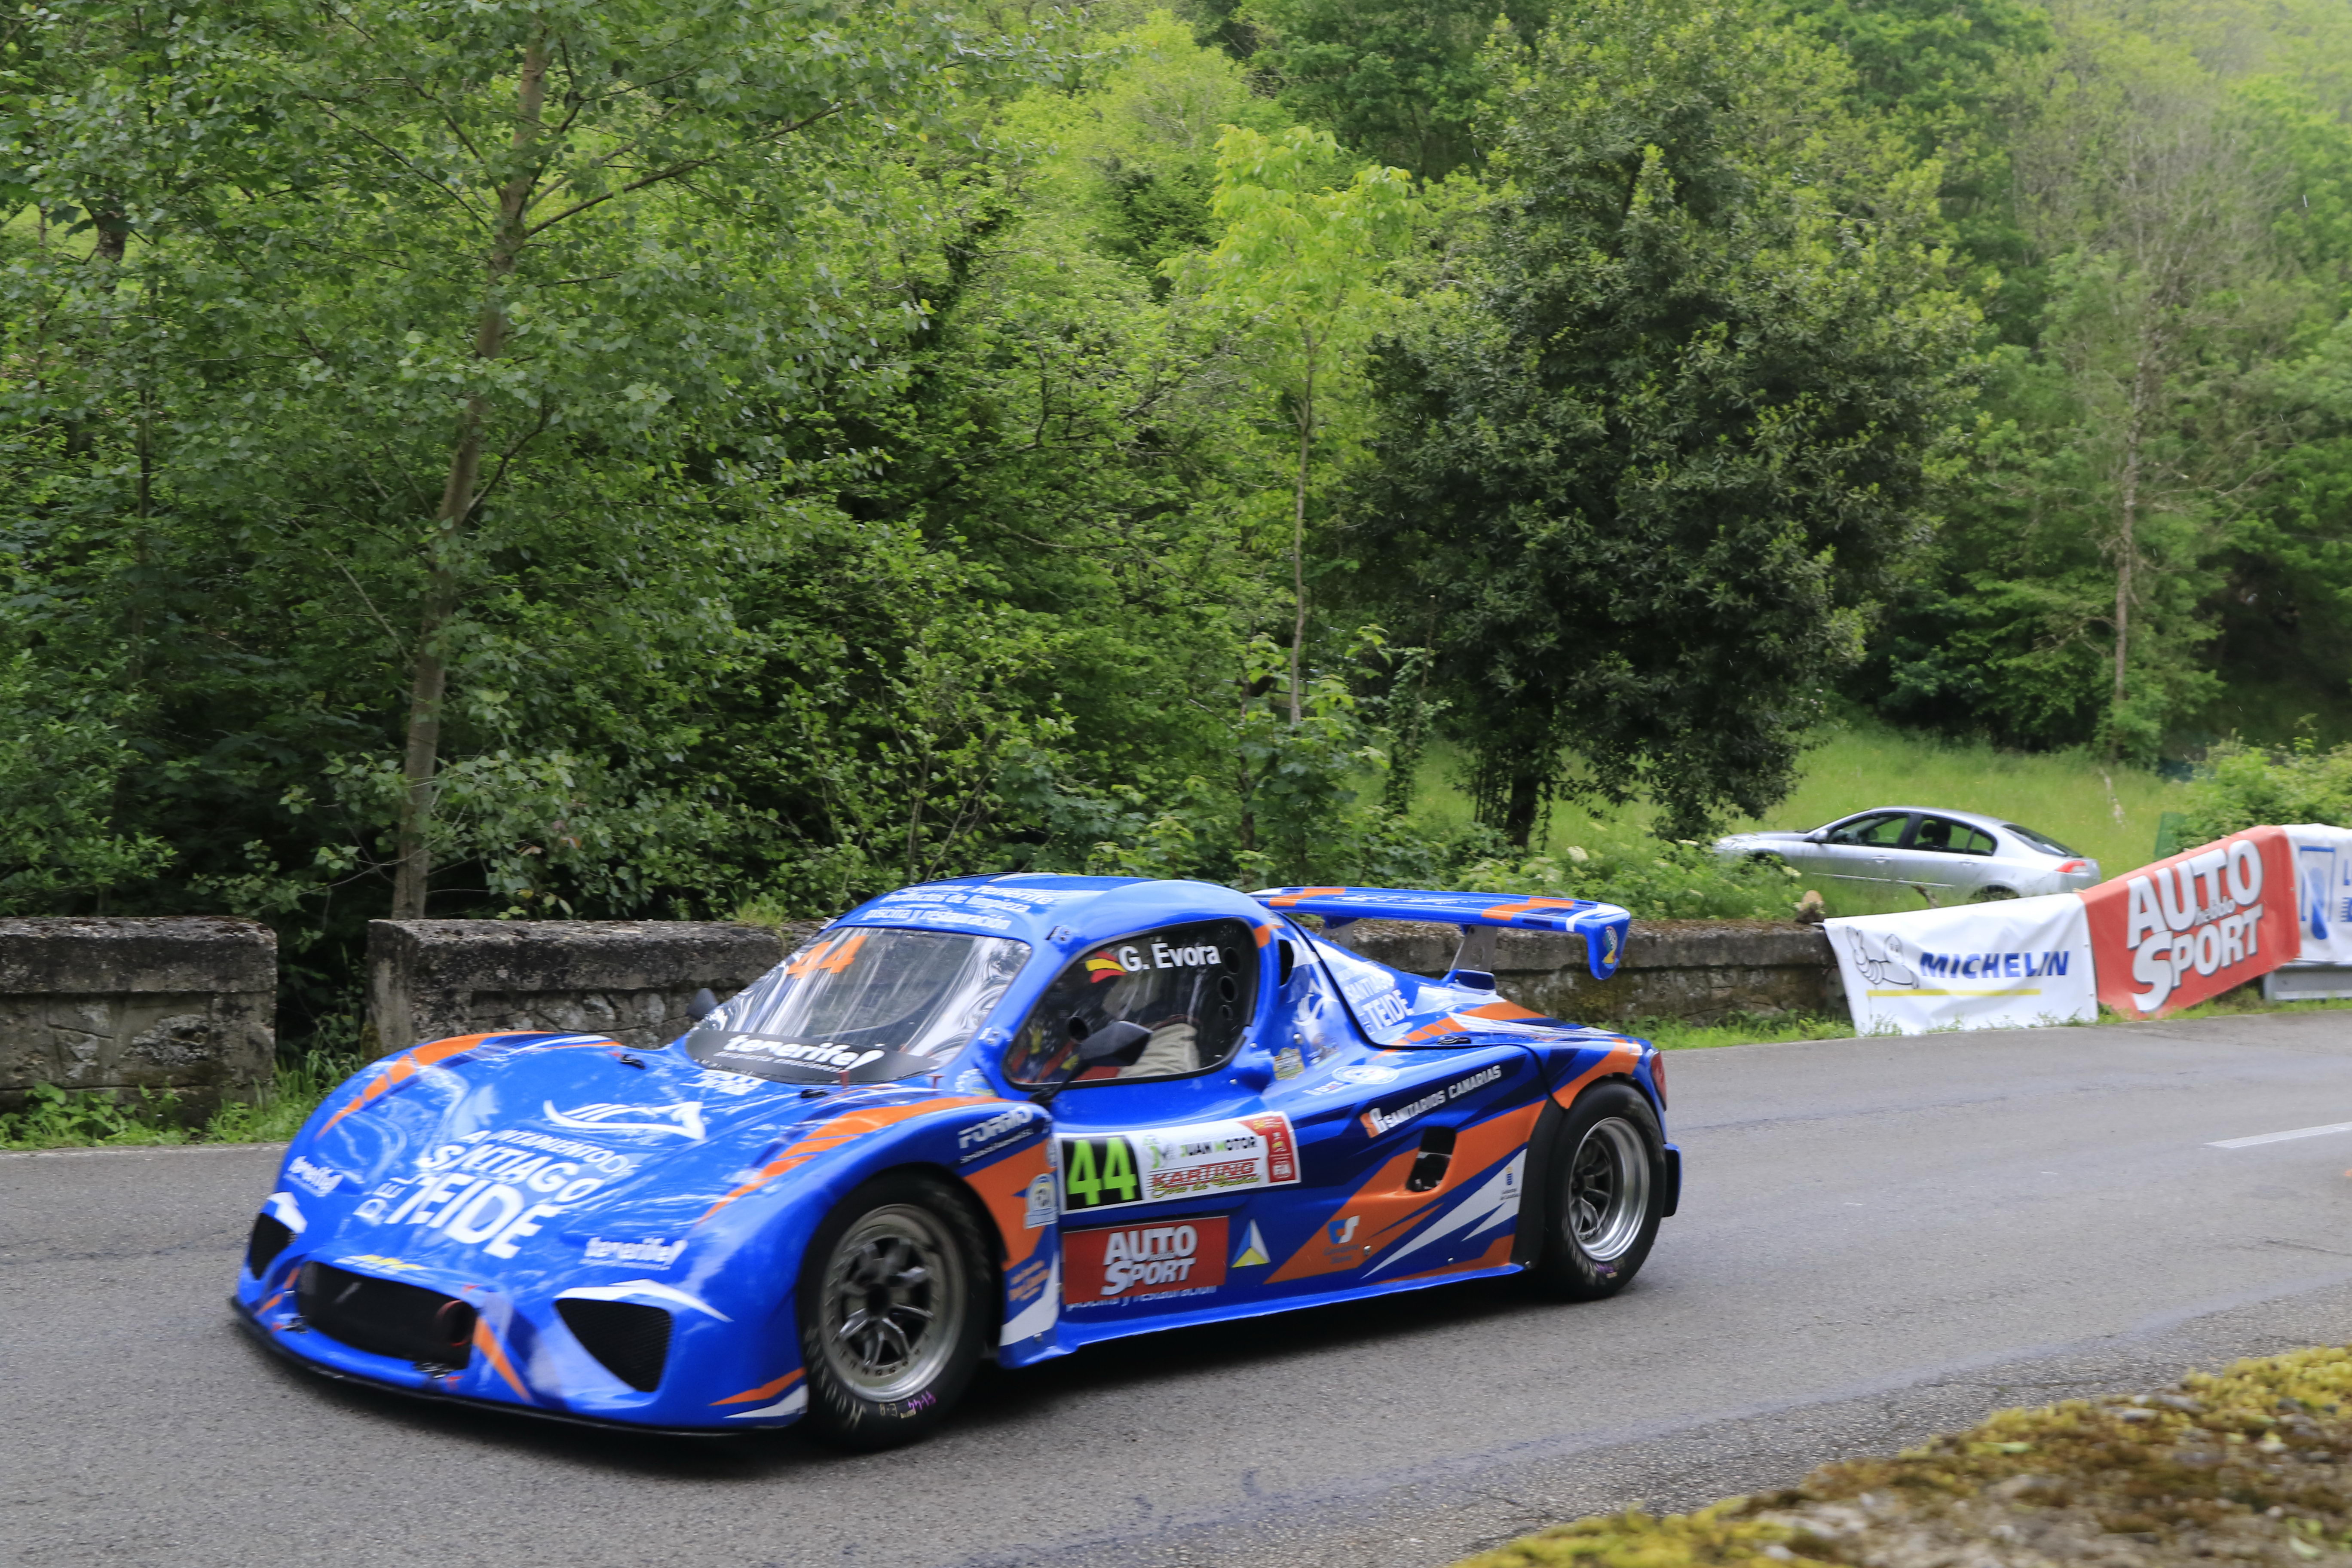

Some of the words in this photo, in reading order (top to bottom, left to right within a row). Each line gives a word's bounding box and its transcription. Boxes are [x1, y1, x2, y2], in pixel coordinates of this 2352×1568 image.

[2127, 839, 2263, 950] AUTO
[786, 935, 867, 979] 44
[1119, 946, 1150, 972] G.
[1920, 951, 2069, 979] MICHELIN
[2132, 904, 2263, 1013] SPORT
[1361, 989, 1415, 1030] TEIDE
[1383, 1090, 1446, 1128] SANITARIOS
[1448, 1065, 1502, 1099] CANARIAS
[1214, 1136, 1257, 1152] MOTOR
[1067, 1136, 1138, 1205] 44
[1152, 1158, 1259, 1187] KARTING
[383, 1172, 564, 1259] TEIDE
[1103, 1225, 1198, 1265] AUTO
[1100, 1258, 1197, 1295] SPORT
